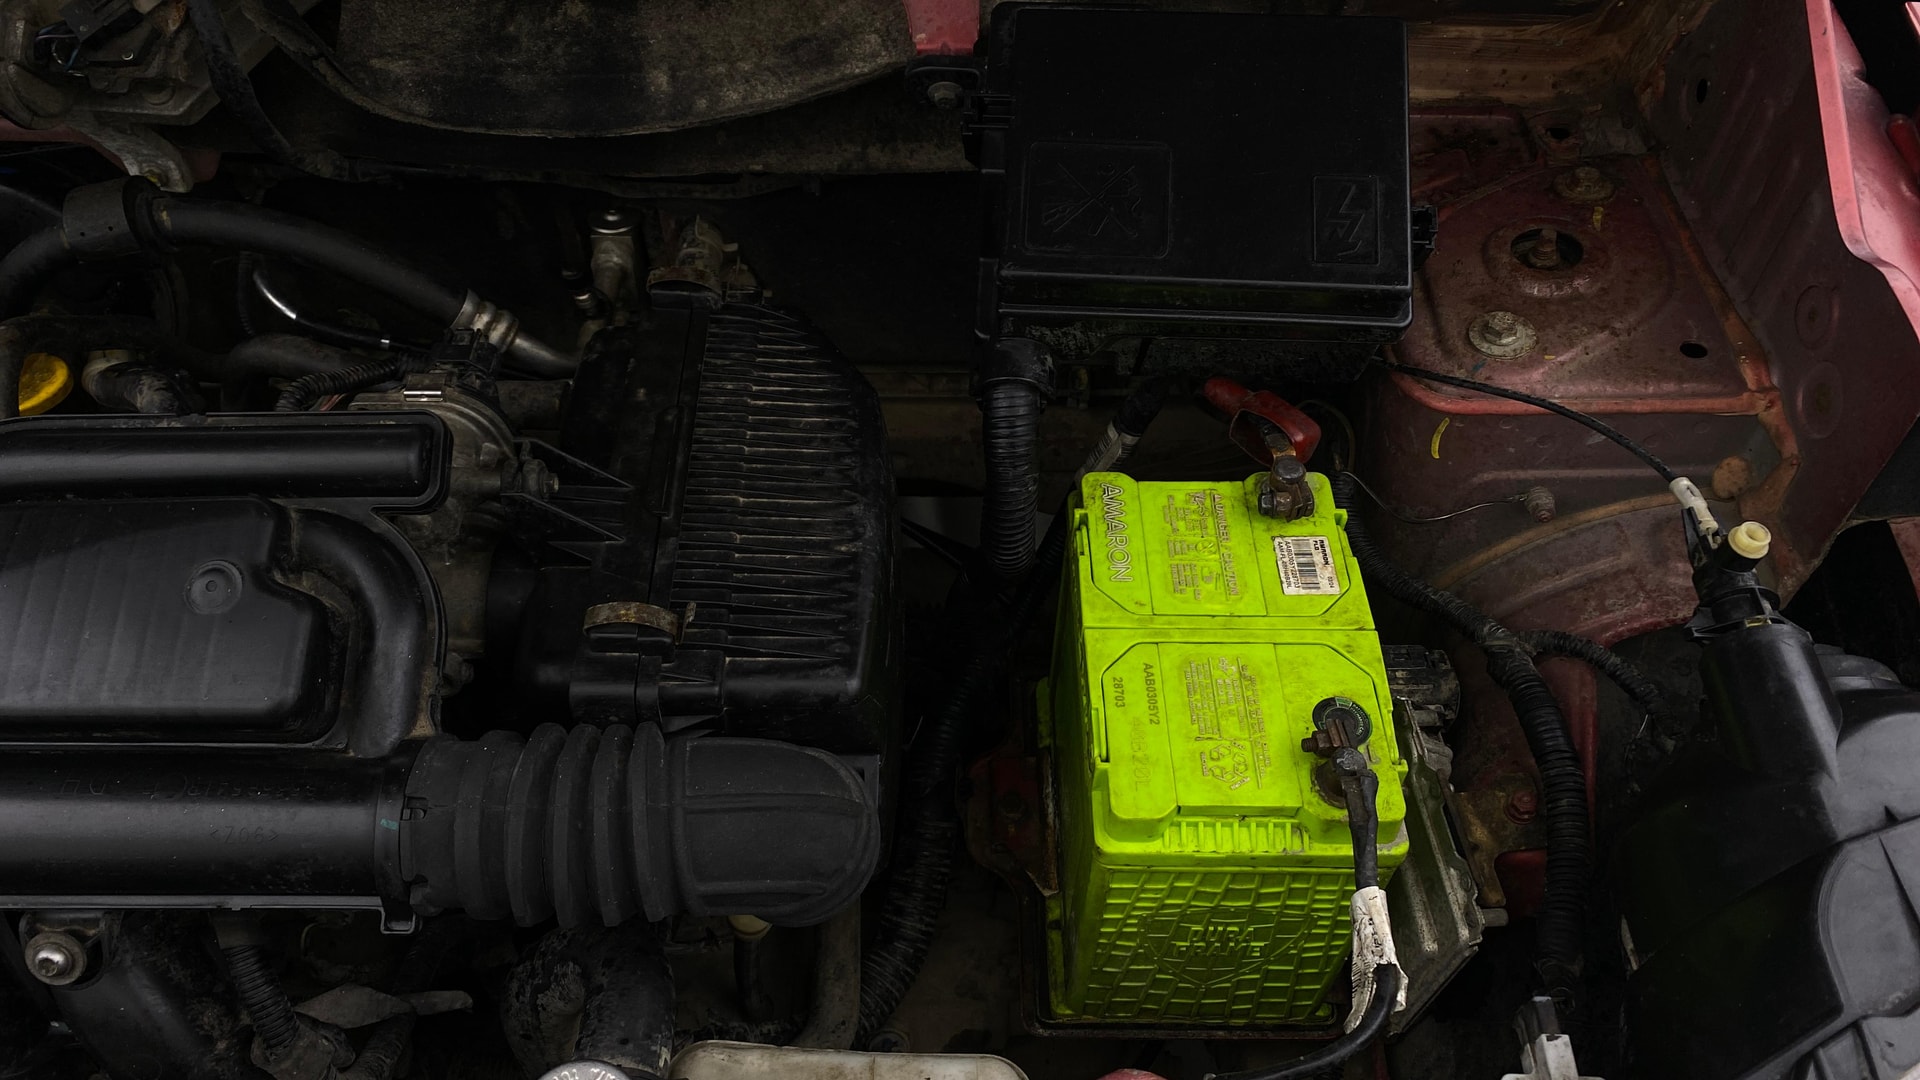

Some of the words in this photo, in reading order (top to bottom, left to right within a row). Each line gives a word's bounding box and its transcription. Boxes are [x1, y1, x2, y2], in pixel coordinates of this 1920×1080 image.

[1101, 483, 1134, 582] AMARON
[1216, 503, 1231, 543] DANGER
[1223, 551, 1241, 597] CAUTION
[1112, 676, 1126, 709] 28703
[1143, 662, 1161, 726] AAB0305Y2
[1173, 941, 1267, 957] FRAME
